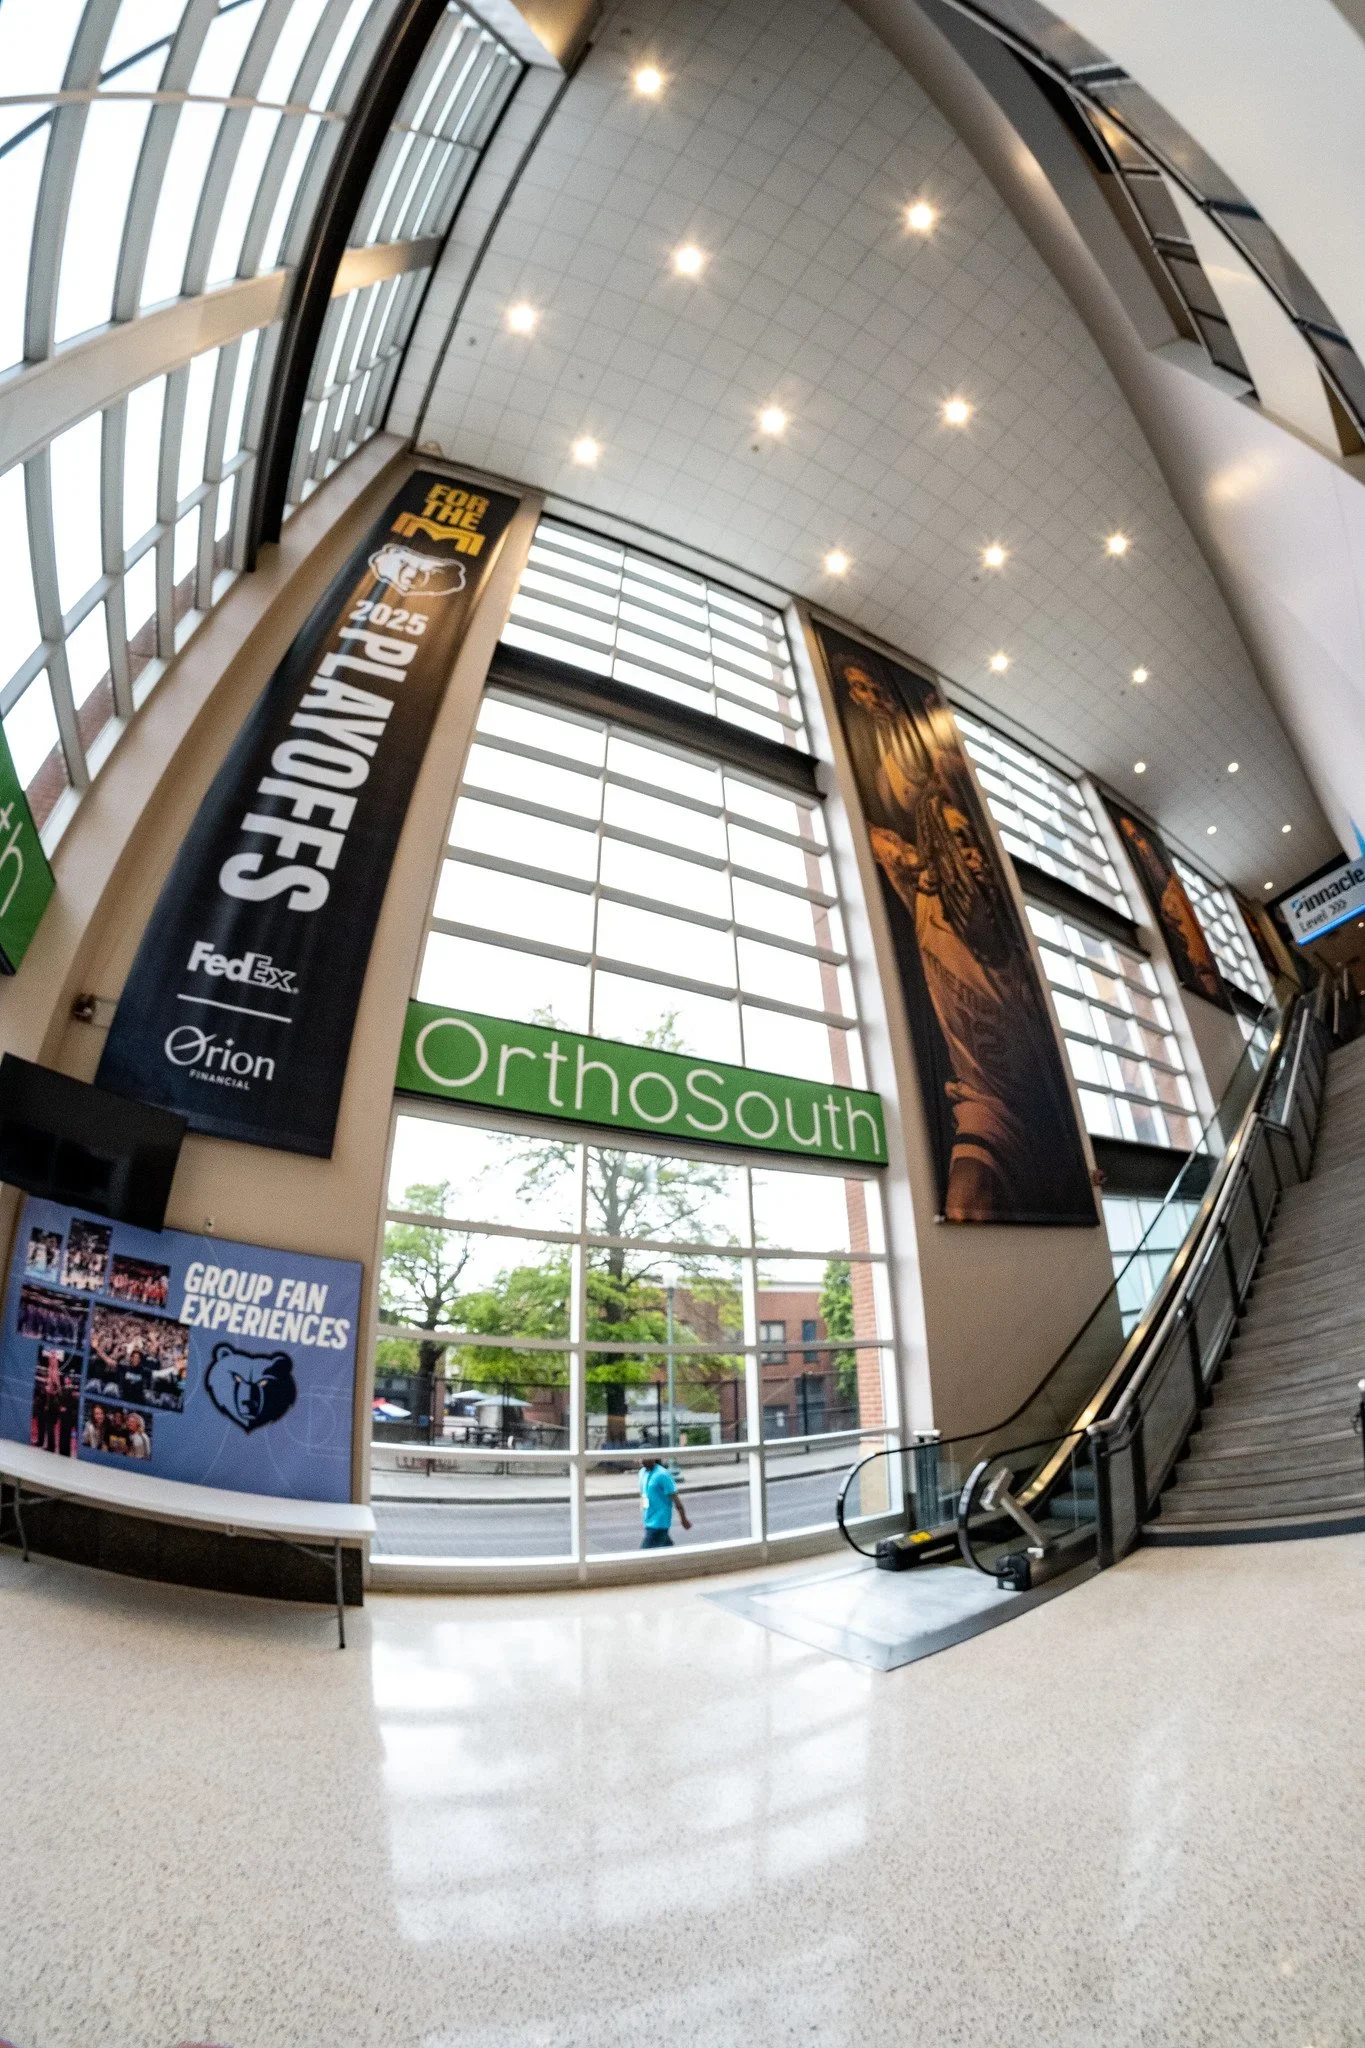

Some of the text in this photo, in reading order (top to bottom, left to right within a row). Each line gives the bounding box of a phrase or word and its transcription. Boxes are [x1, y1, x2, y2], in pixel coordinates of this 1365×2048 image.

[421, 499, 483, 531] THE
[427, 483, 490, 513] FOR
[349, 599, 430, 636] 2025
[218, 626, 418, 912] PLAYOFFS
[1291, 868, 1365, 918] Pinnacle
[1299, 909, 1328, 932] Level
[186, 940, 299, 994] FedEx
[164, 1025, 276, 1081] Orion
[188, 1068, 251, 1091] FINANCIAL
[415, 1017, 880, 1155] OrthoSouth
[184, 1261, 329, 1315] GROUP FAN
[179, 1293, 350, 1350] EXPERIENCES
